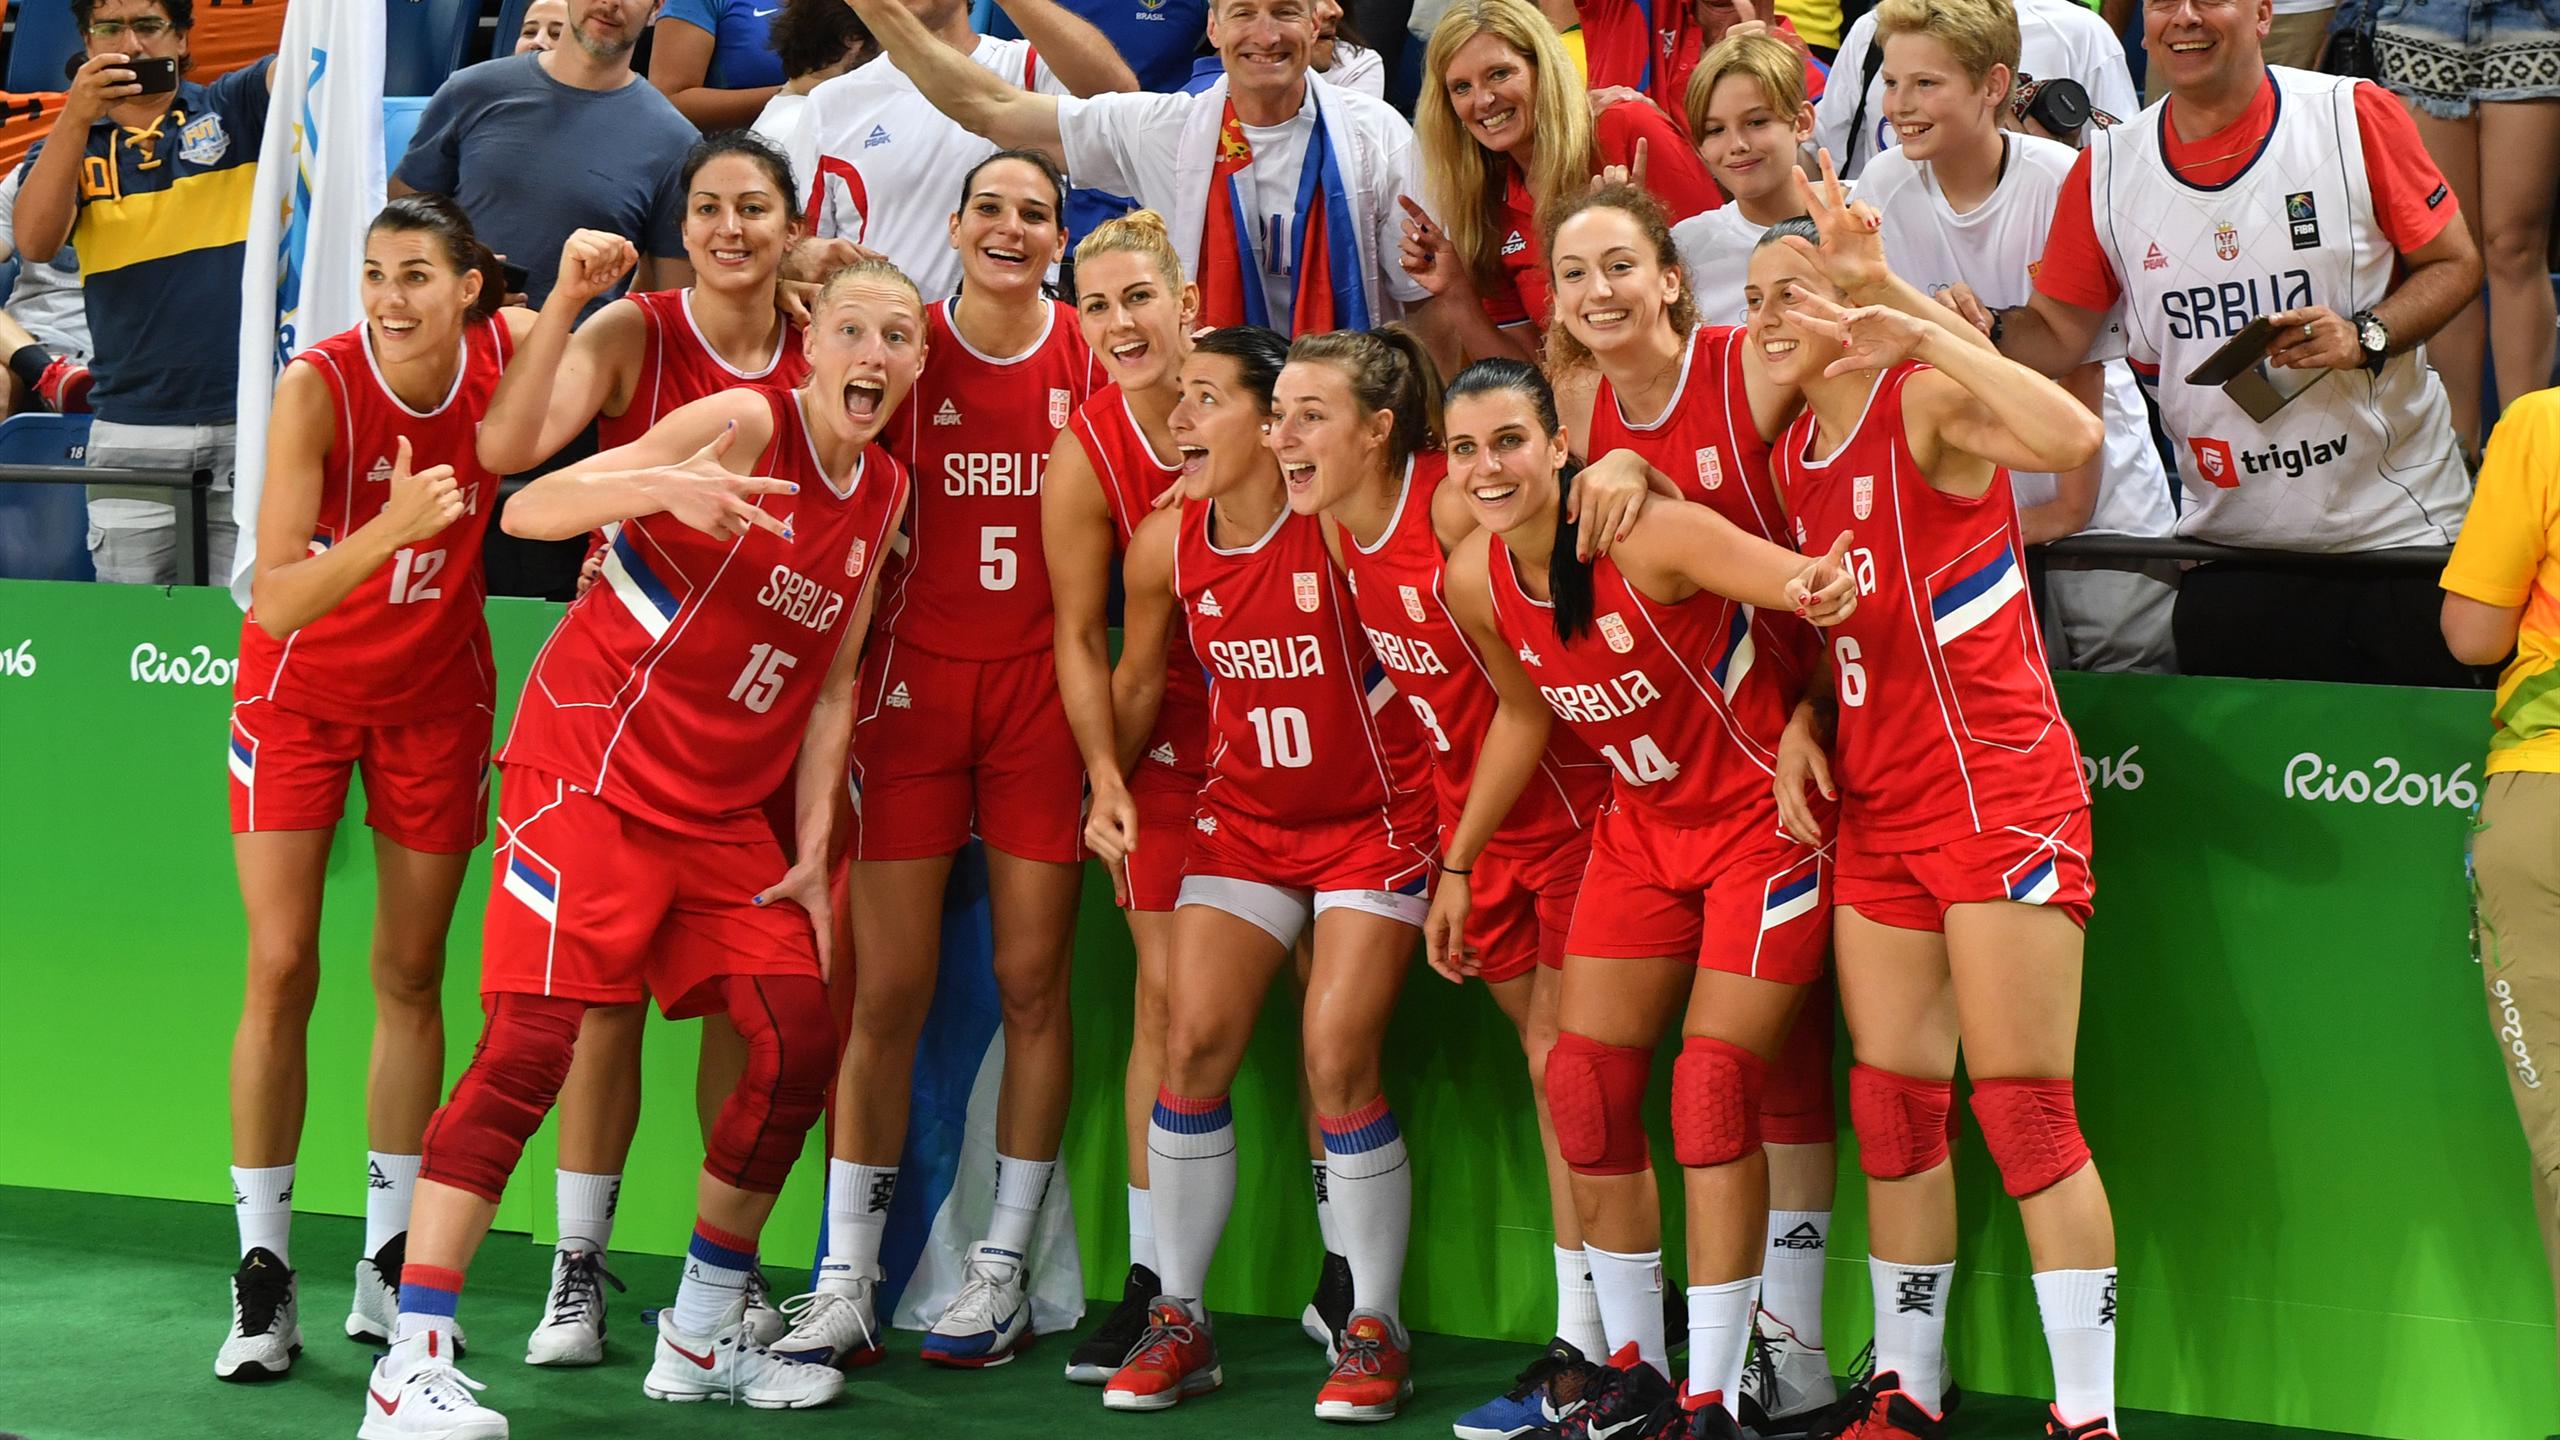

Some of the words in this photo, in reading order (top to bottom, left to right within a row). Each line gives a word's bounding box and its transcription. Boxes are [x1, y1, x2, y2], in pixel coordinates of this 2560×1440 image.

[1135, 12, 1165, 21] BRASIL
[864, 134, 891, 149] PEAK
[1501, 241, 1527, 256] PEAK
[2294, 224, 2315, 235] FIBA
[2143, 257, 2169, 271] PEAK
[933, 413, 962, 426] PEAK
[69, 446, 84, 460] 18
[2241, 434, 2348, 478] triglav
[388, 548, 447, 604] 12
[979, 526, 1018, 591] 5
[727, 642, 798, 714] 15
[1209, 635, 1325, 679] SRBIJA
[1835, 636, 1868, 708] 6
[886, 695, 912, 709] PEAK
[1247, 706, 1313, 769] 10
[1600, 734, 1680, 787] 14
[2284, 752, 2478, 809] Rio2016
[2490, 979, 2542, 1089] Rio2016
[868, 1172, 897, 1214] PEAK
[1774, 1238, 1825, 1250] PEAK
[1896, 1271, 1941, 1317] PEAK
